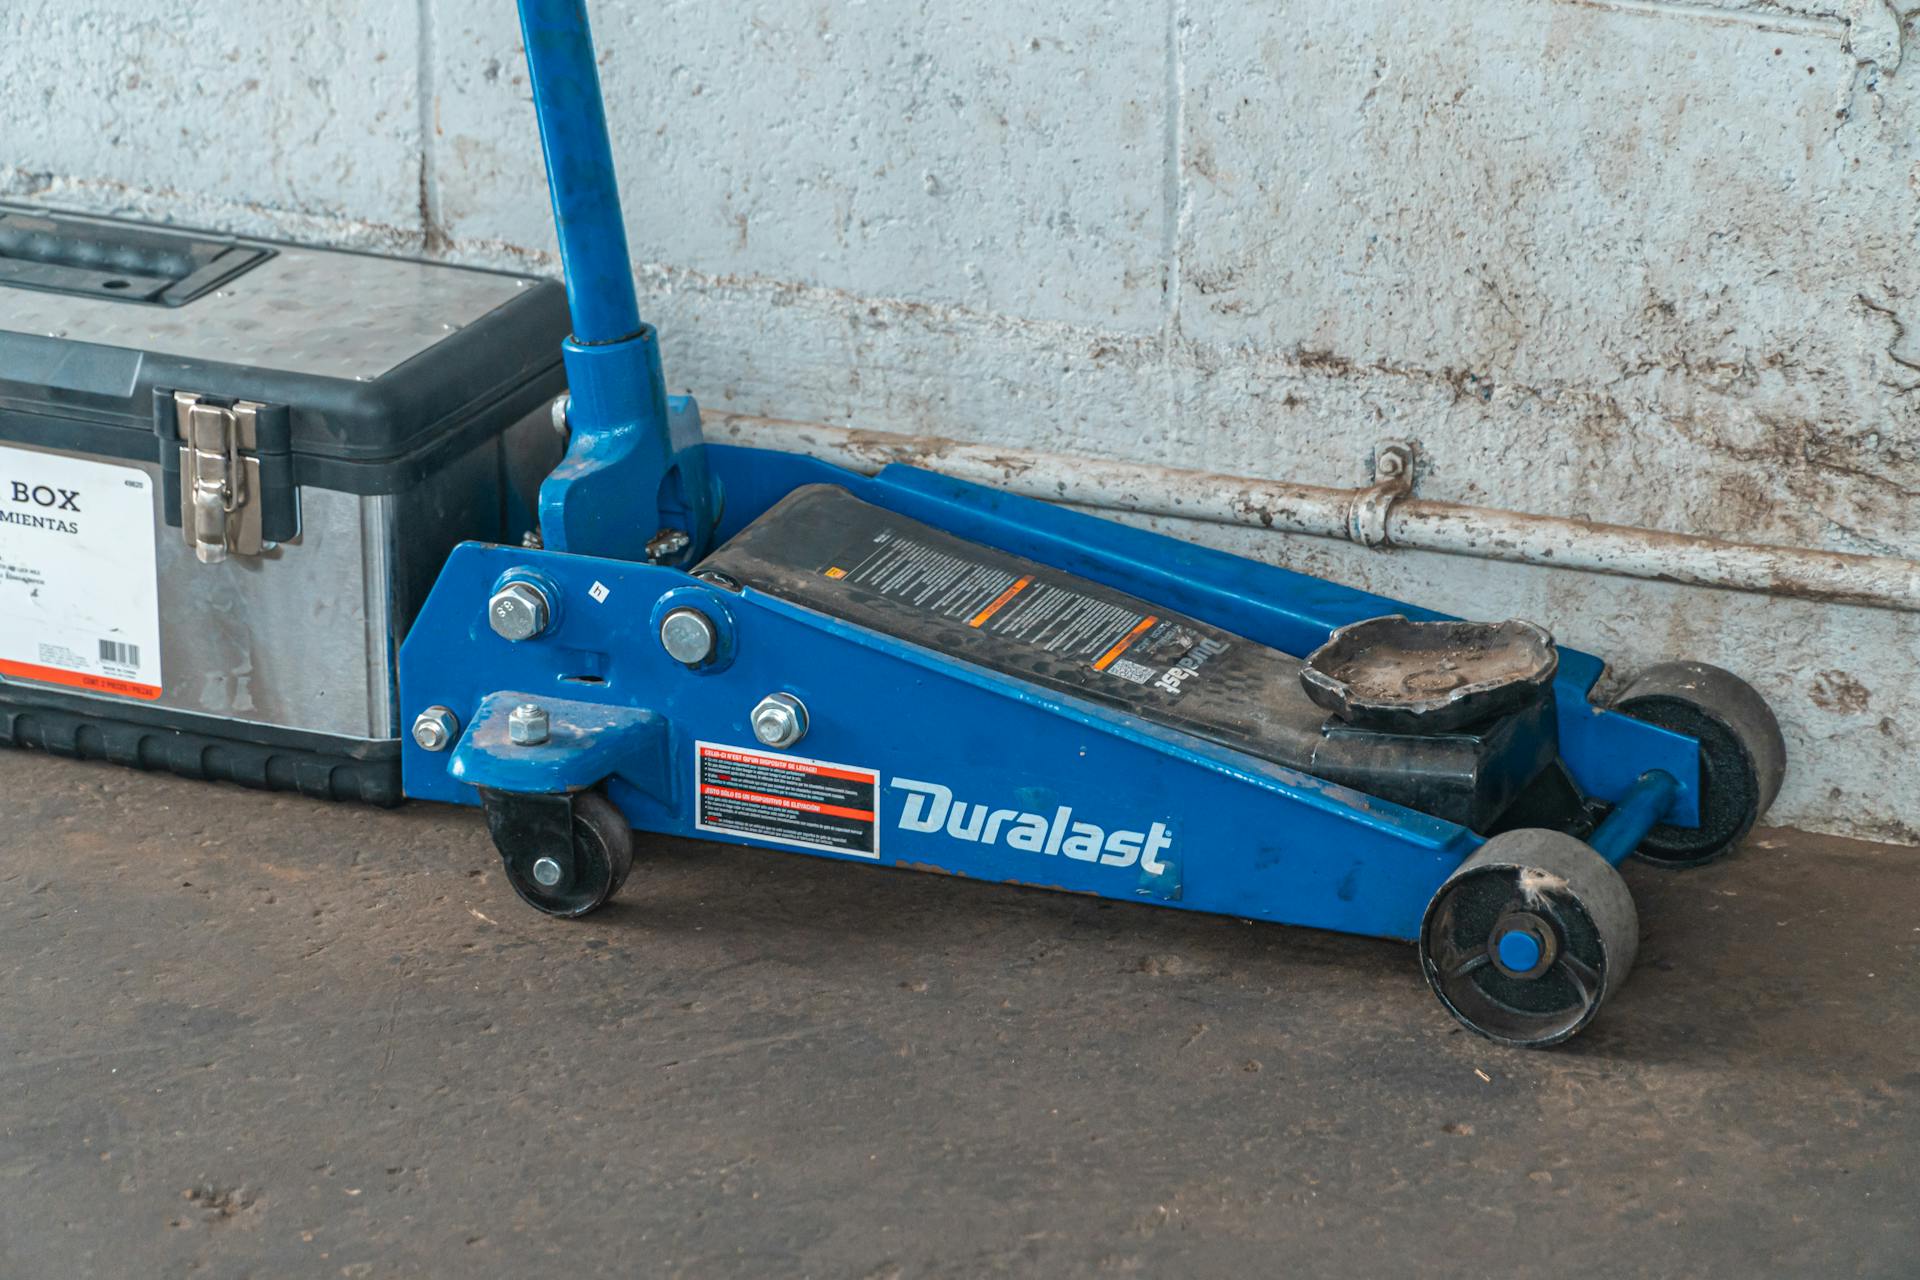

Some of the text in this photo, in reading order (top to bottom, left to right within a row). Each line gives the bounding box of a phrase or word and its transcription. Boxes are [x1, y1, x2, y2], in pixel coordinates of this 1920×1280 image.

[11, 480, 81, 512] BOX
[0, 510, 79, 534] MIENTAS
[891, 776, 1172, 875] Duralast
